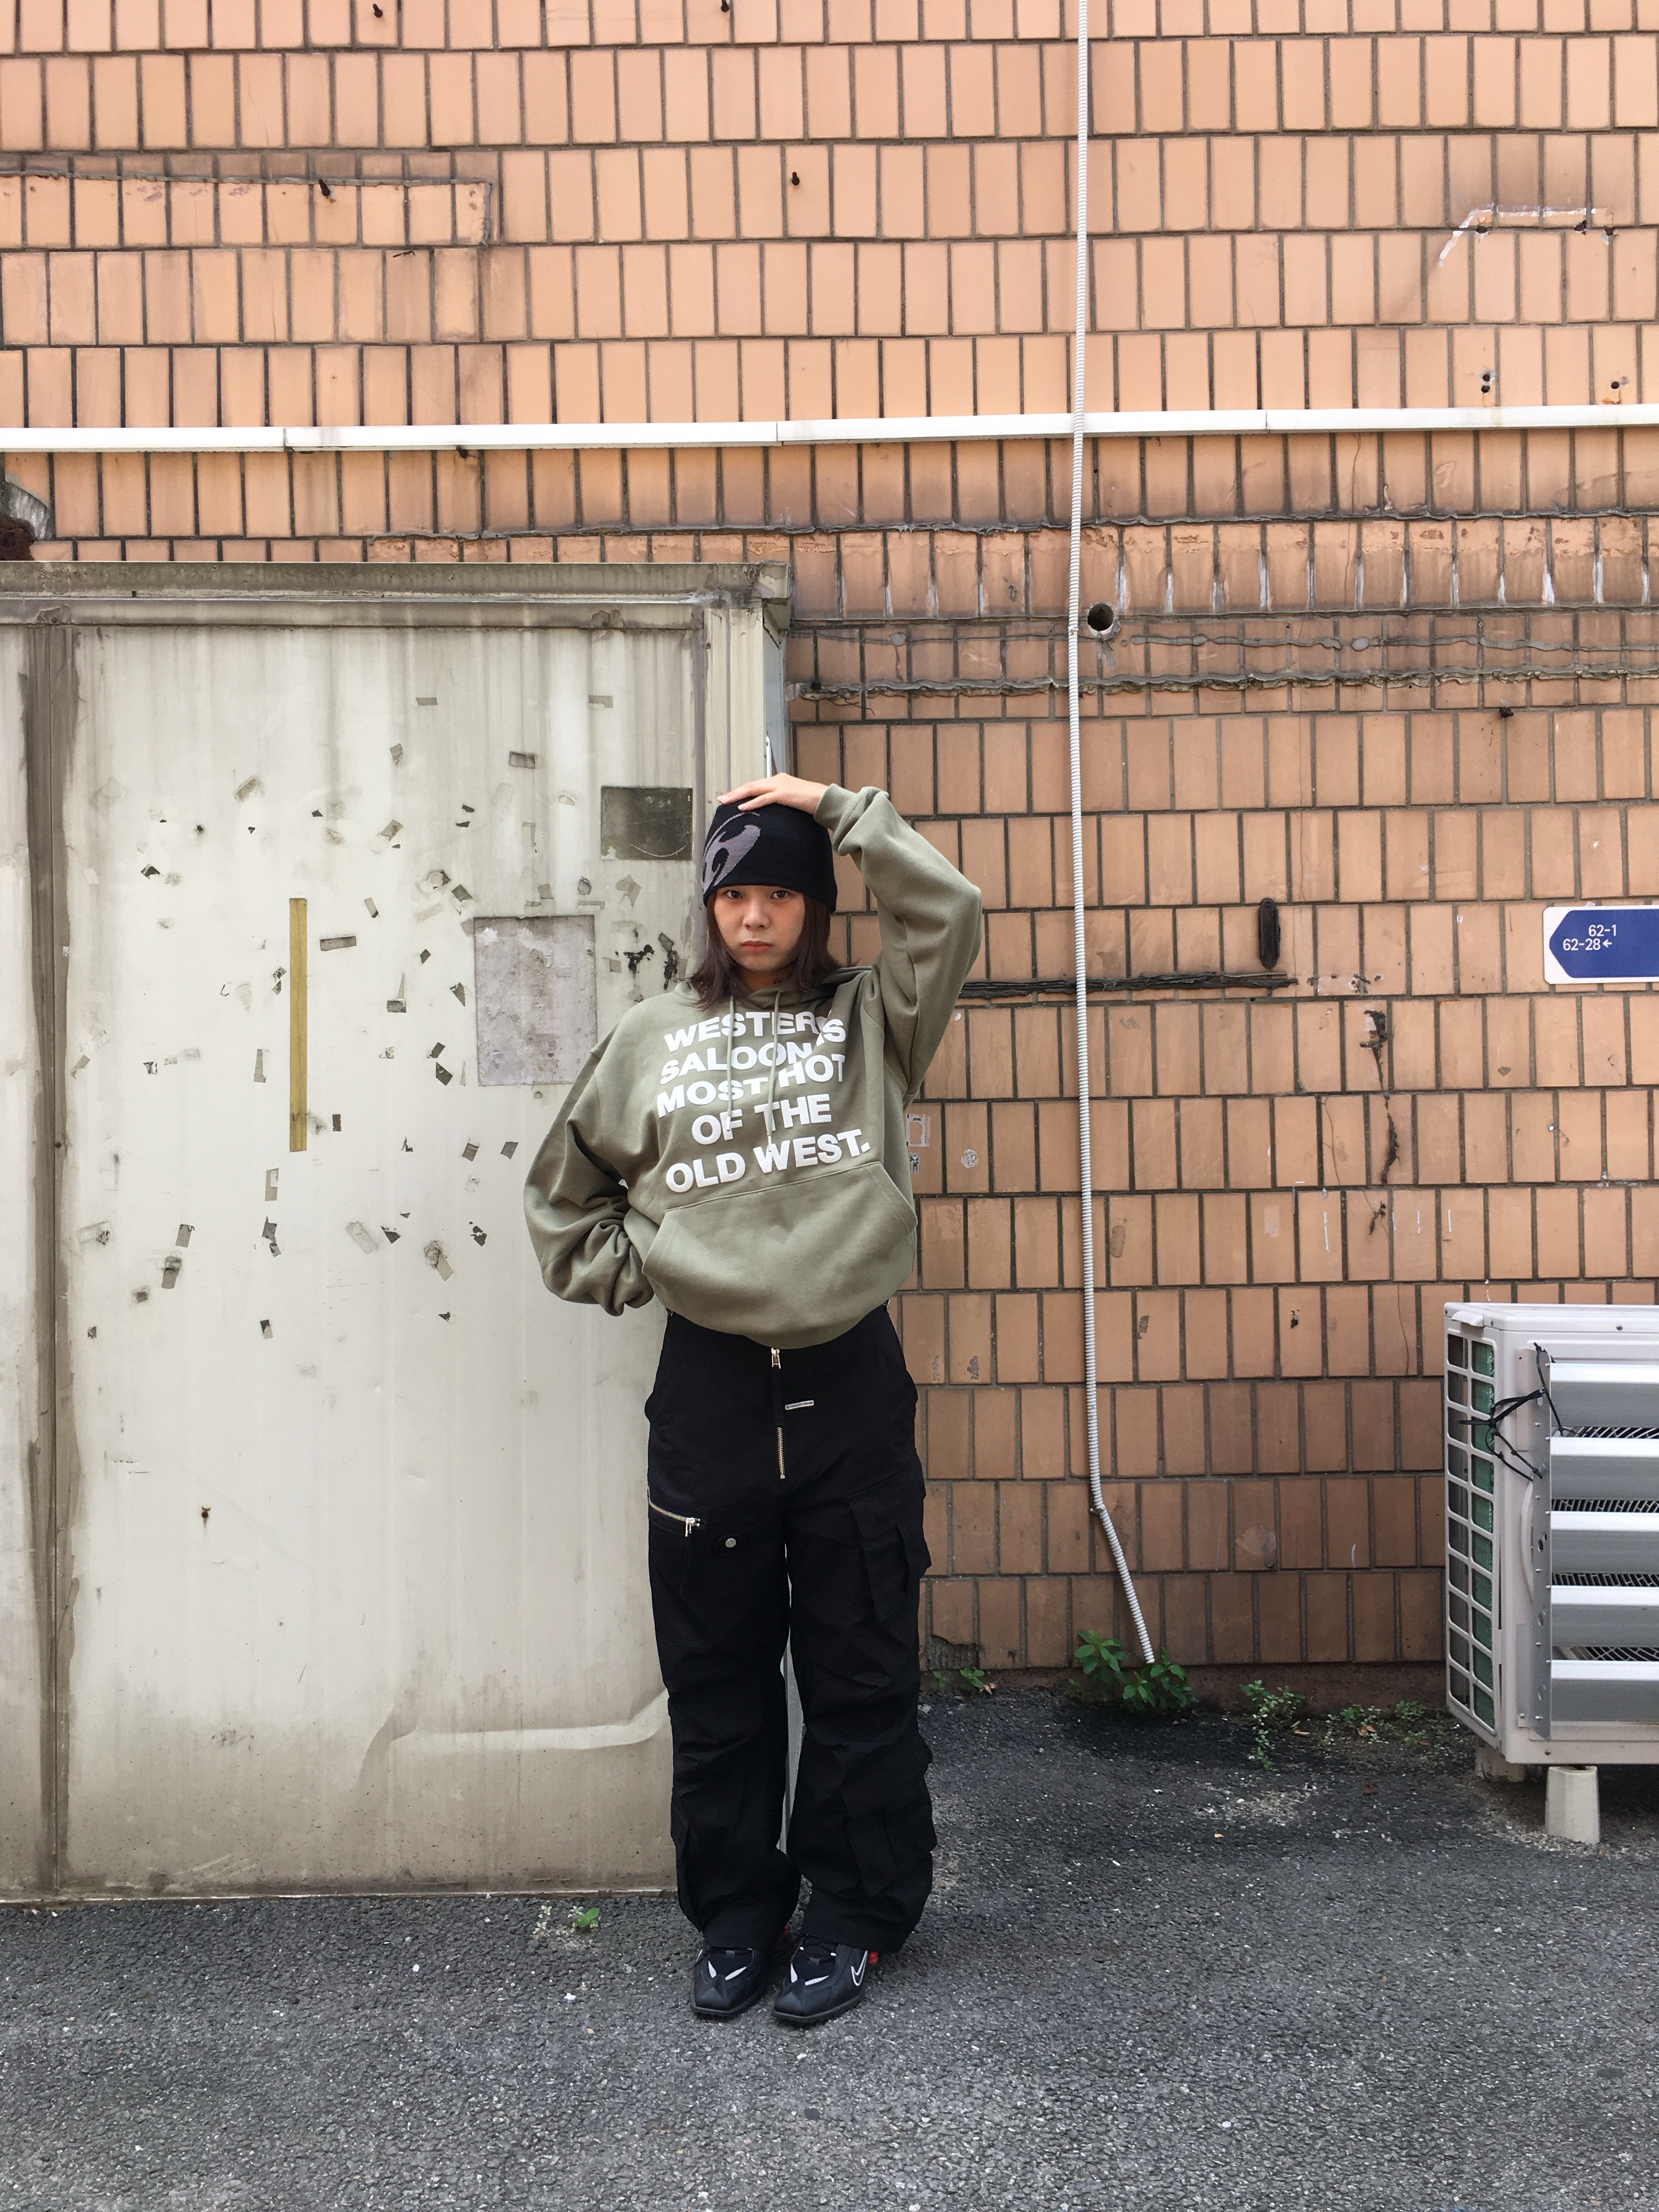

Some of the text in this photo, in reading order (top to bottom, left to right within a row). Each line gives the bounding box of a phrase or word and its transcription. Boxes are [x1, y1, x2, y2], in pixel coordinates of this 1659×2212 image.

[1562, 938, 1601, 951] 62-28
[1588, 924, 1617, 937] 62-1
[657, 1053, 845, 1118] MOST HOT
[692, 1094, 832, 1144] OF THE
[666, 1129, 871, 1193] OLD WEST.
